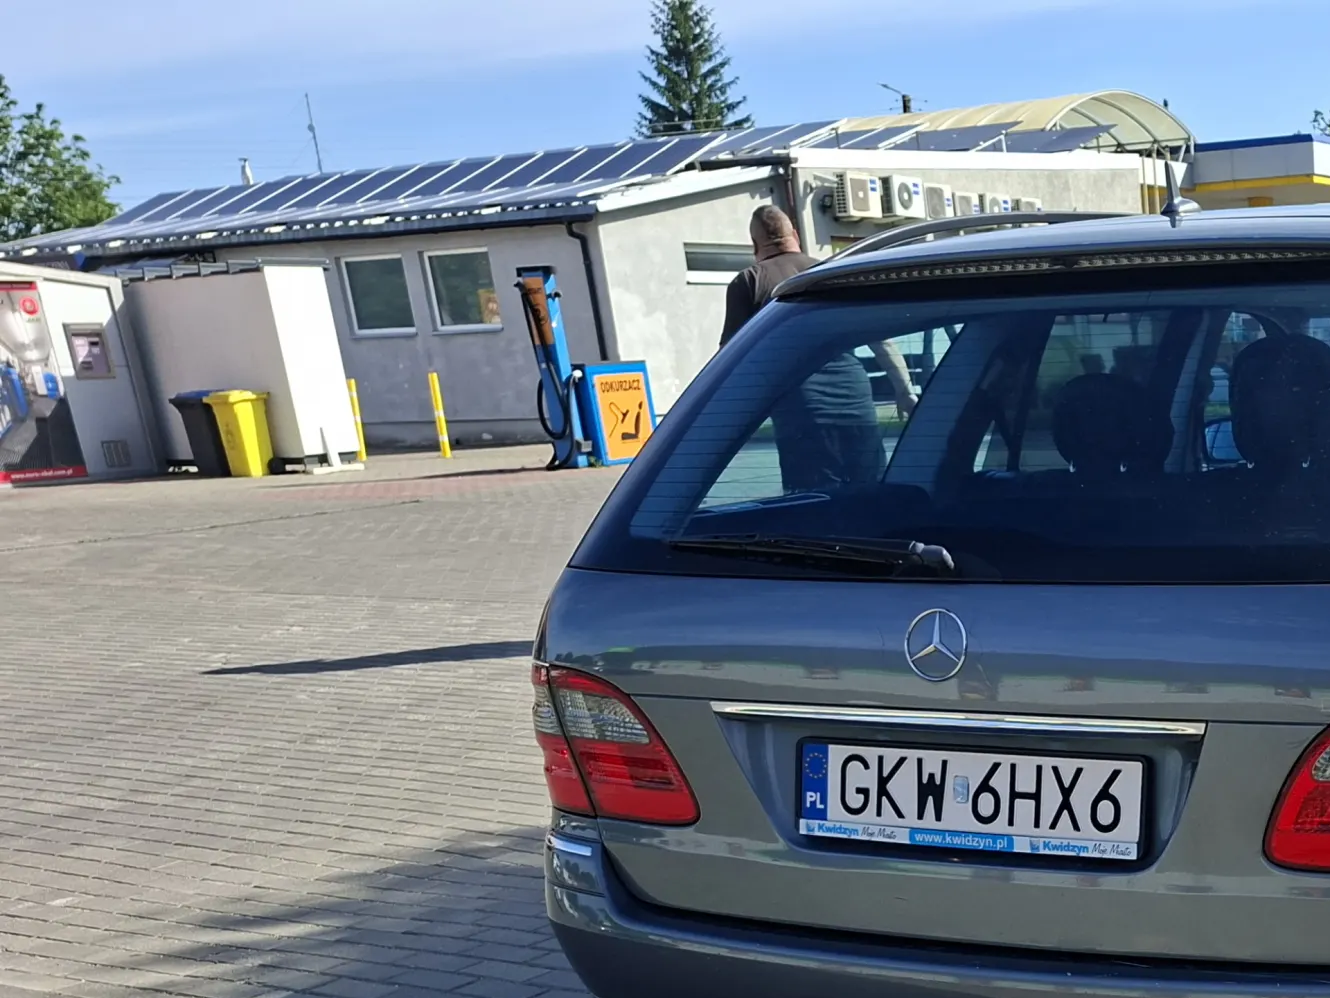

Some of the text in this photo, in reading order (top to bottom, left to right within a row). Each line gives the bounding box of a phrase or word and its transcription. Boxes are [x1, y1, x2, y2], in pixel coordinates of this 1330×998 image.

[600, 379, 641, 393] ODKURZACZ
[806, 791, 825, 809] PL
[839, 753, 1123, 834] GKW 6HX6
[817, 822, 897, 840] Kwidzyn Moje Miasto
[914, 832, 1008, 849] www.kwidzyn.pl
[1042, 841, 1132, 857] Kwidzyn Moje Miasto
